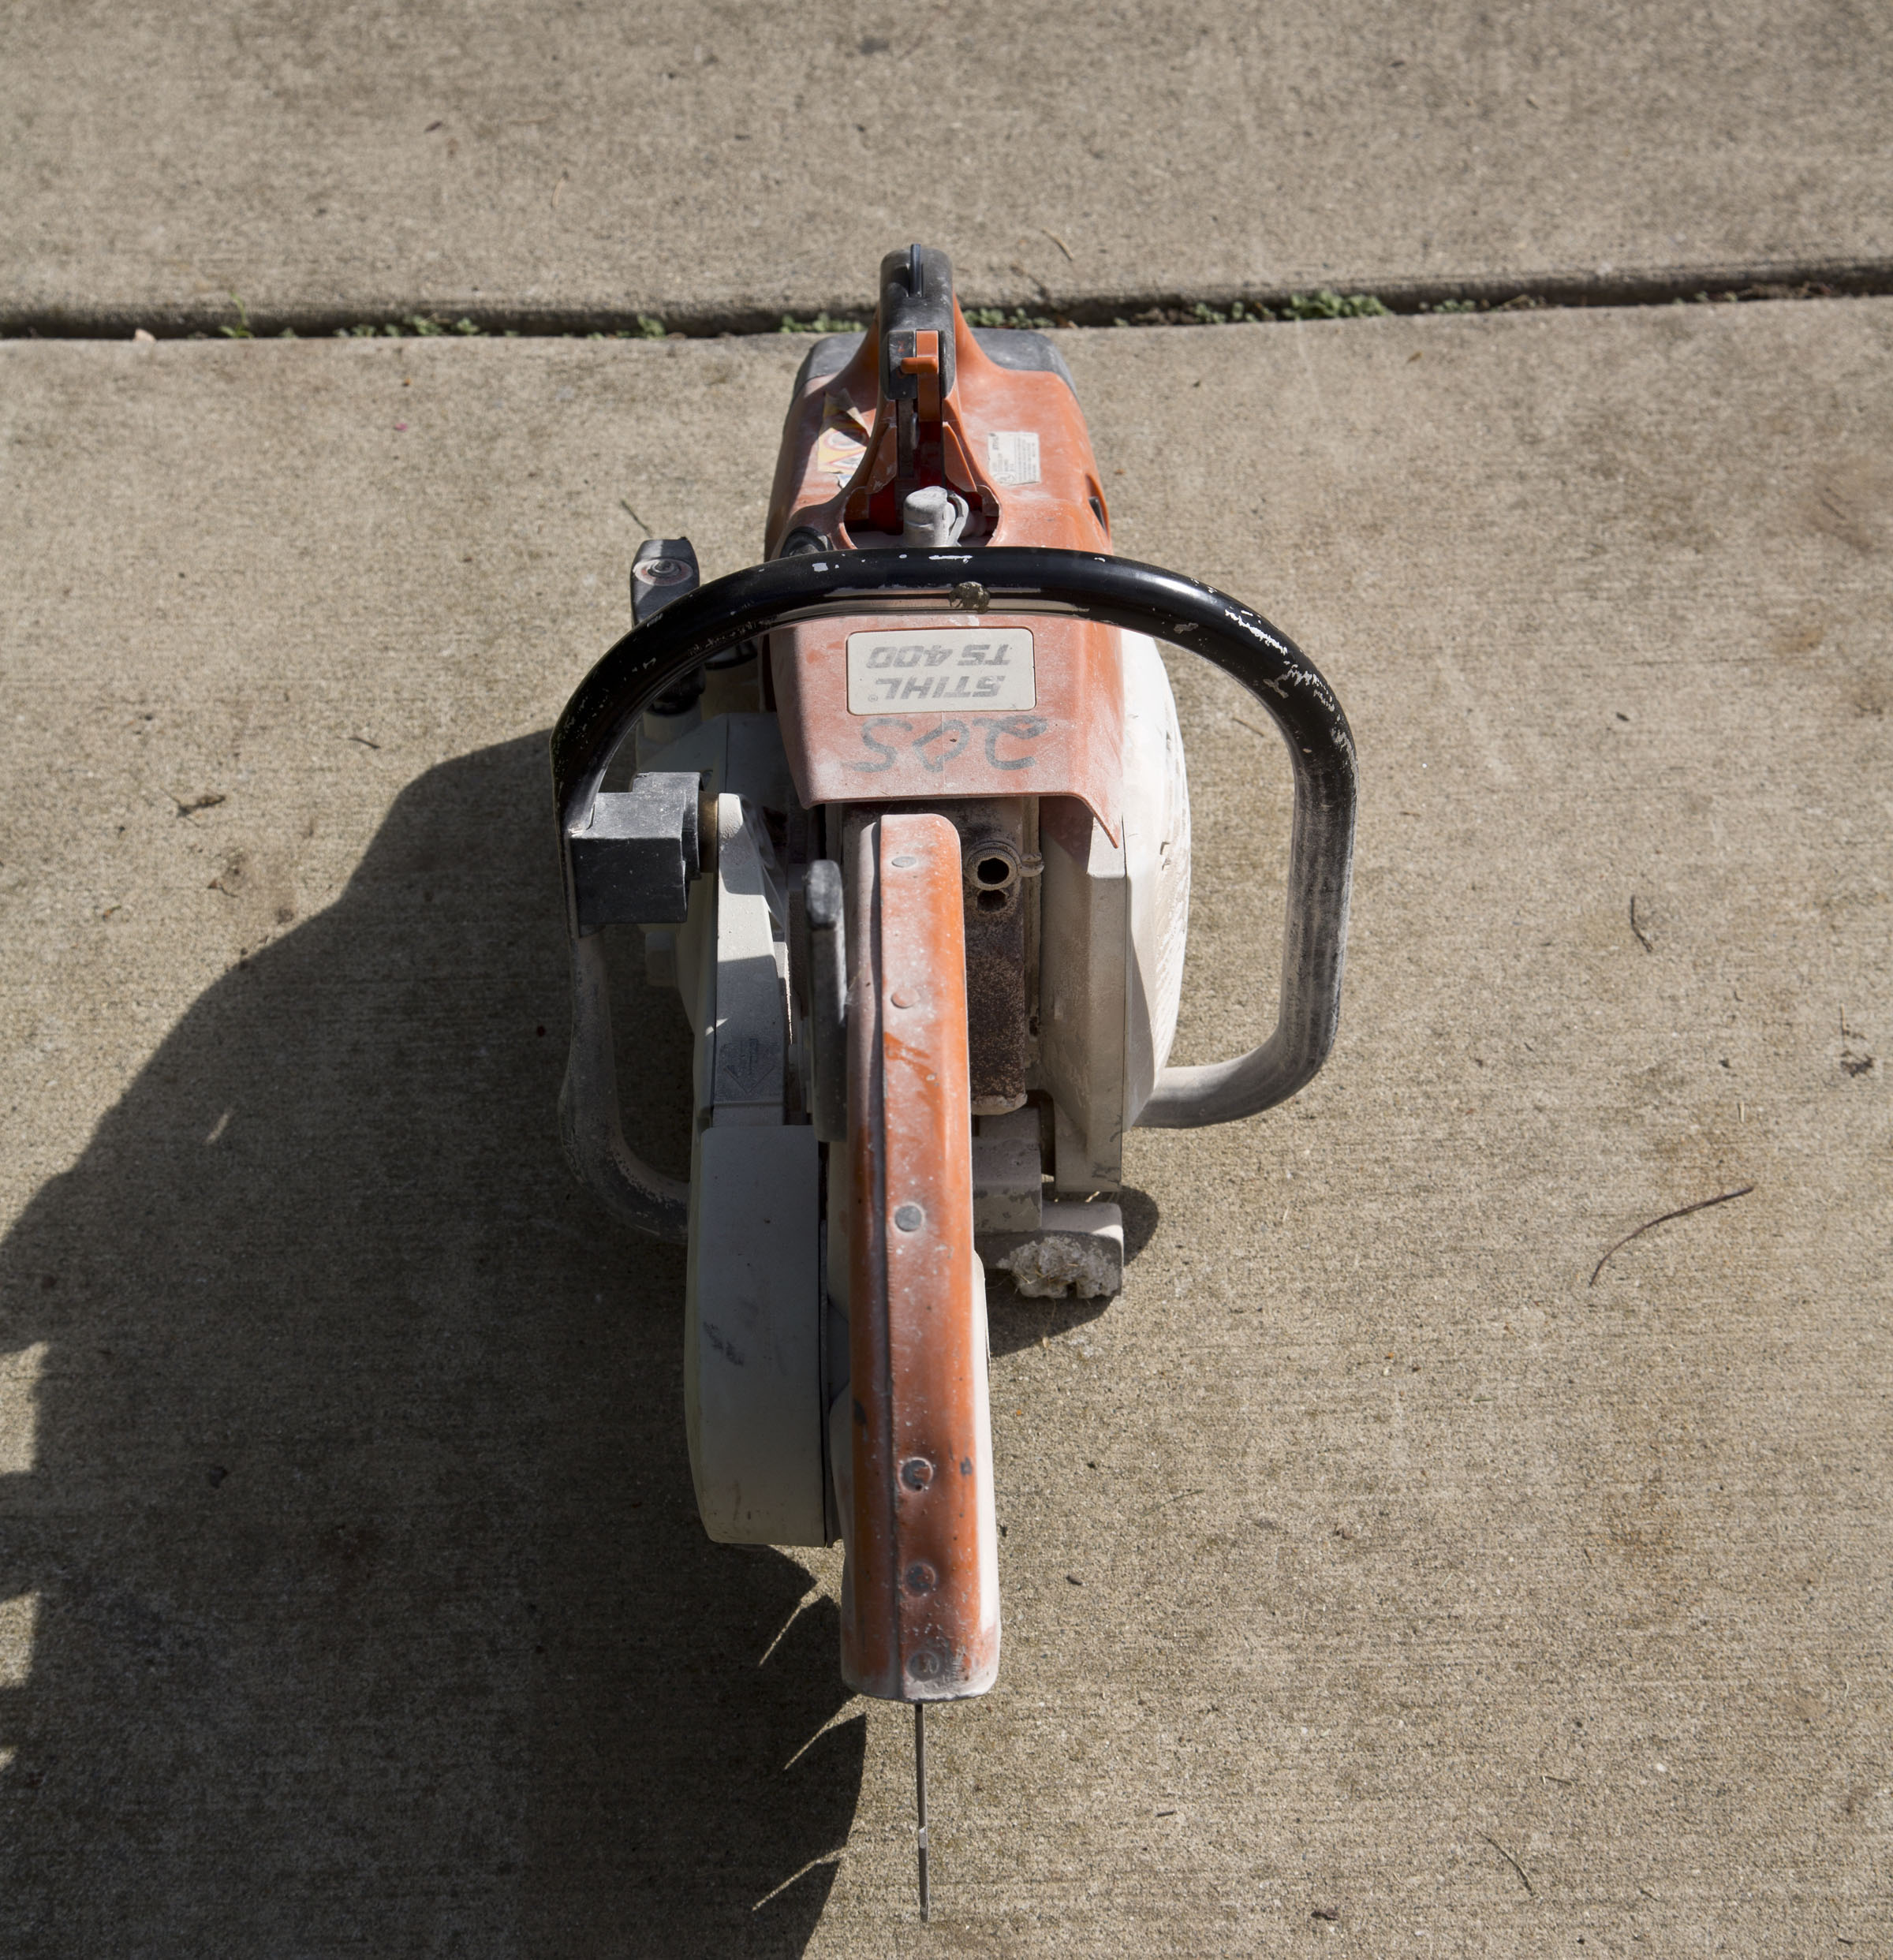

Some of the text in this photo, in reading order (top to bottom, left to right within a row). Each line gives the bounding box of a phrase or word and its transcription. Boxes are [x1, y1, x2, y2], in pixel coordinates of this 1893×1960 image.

[866, 644, 1012, 670] TS 400
[876, 676, 1005, 700] STIHL
[842, 716, 1048, 773] 205
